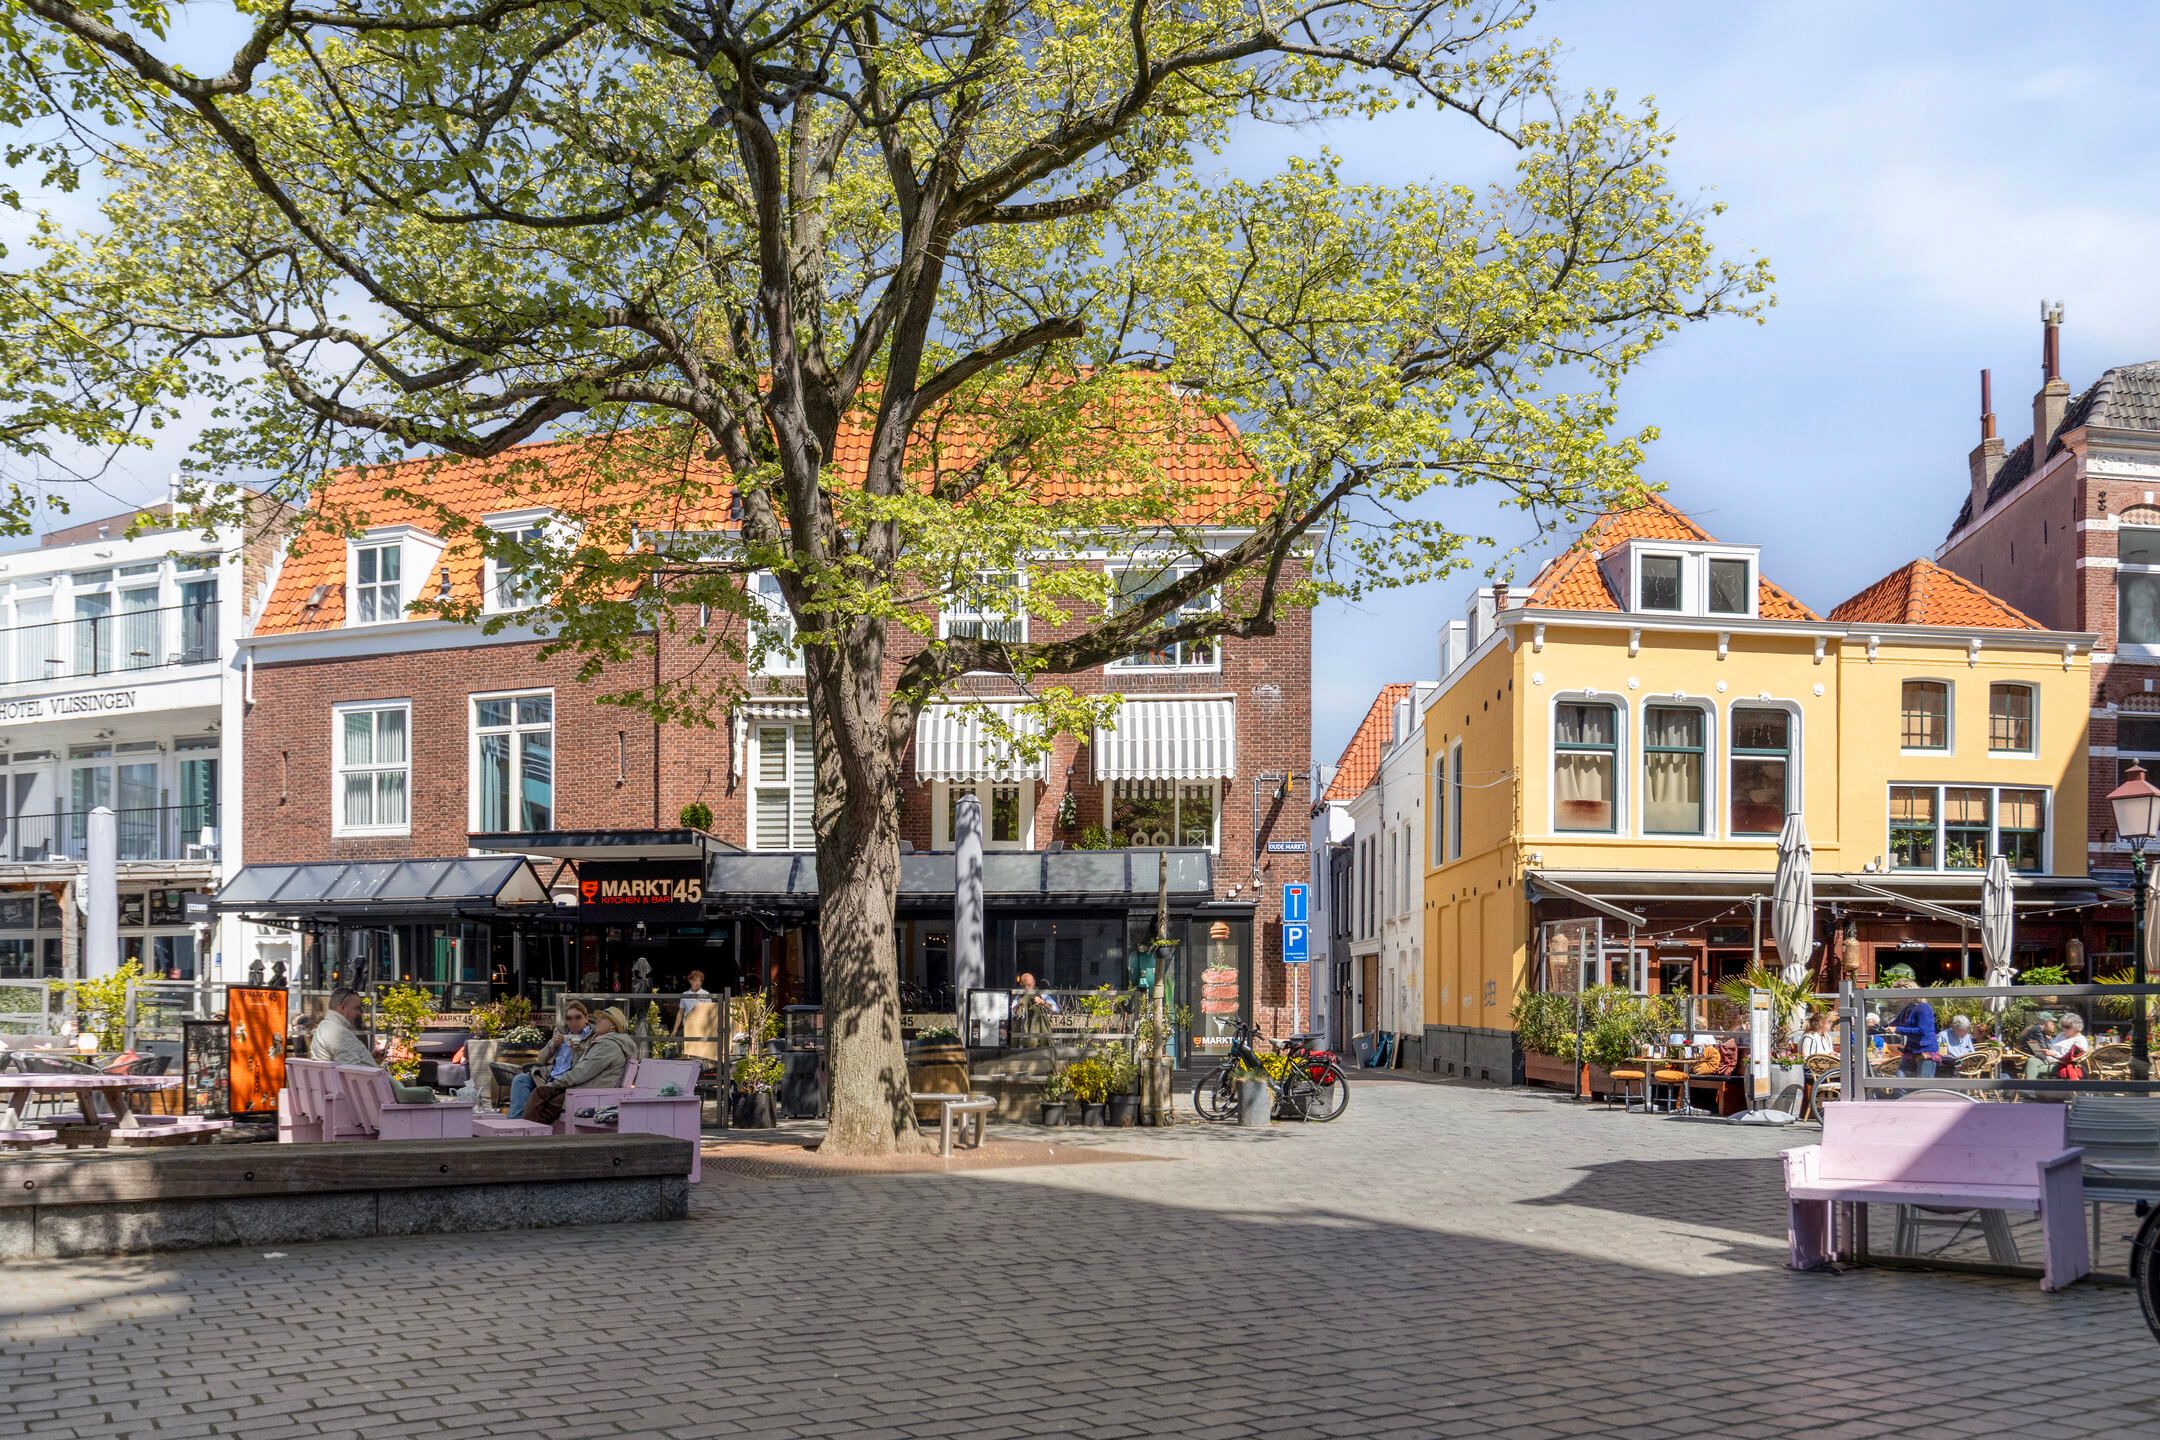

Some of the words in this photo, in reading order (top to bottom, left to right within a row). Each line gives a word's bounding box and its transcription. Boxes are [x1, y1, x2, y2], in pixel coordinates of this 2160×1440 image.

[0, 701, 42, 719] HOTEL
[50, 691, 136, 714] VLISSINGEN
[601, 880, 671, 897] MARKT
[673, 879, 702, 903] 45
[601, 896, 640, 904] KITCHEN
[1288, 927, 1303, 946] P
[437, 1015, 463, 1023] MARKT
[463, 1015, 473, 1026] 45
[901, 1016, 914, 1027] 45
[1060, 1016, 1073, 1027] 45
[1202, 1036, 1232, 1045] MARKT
